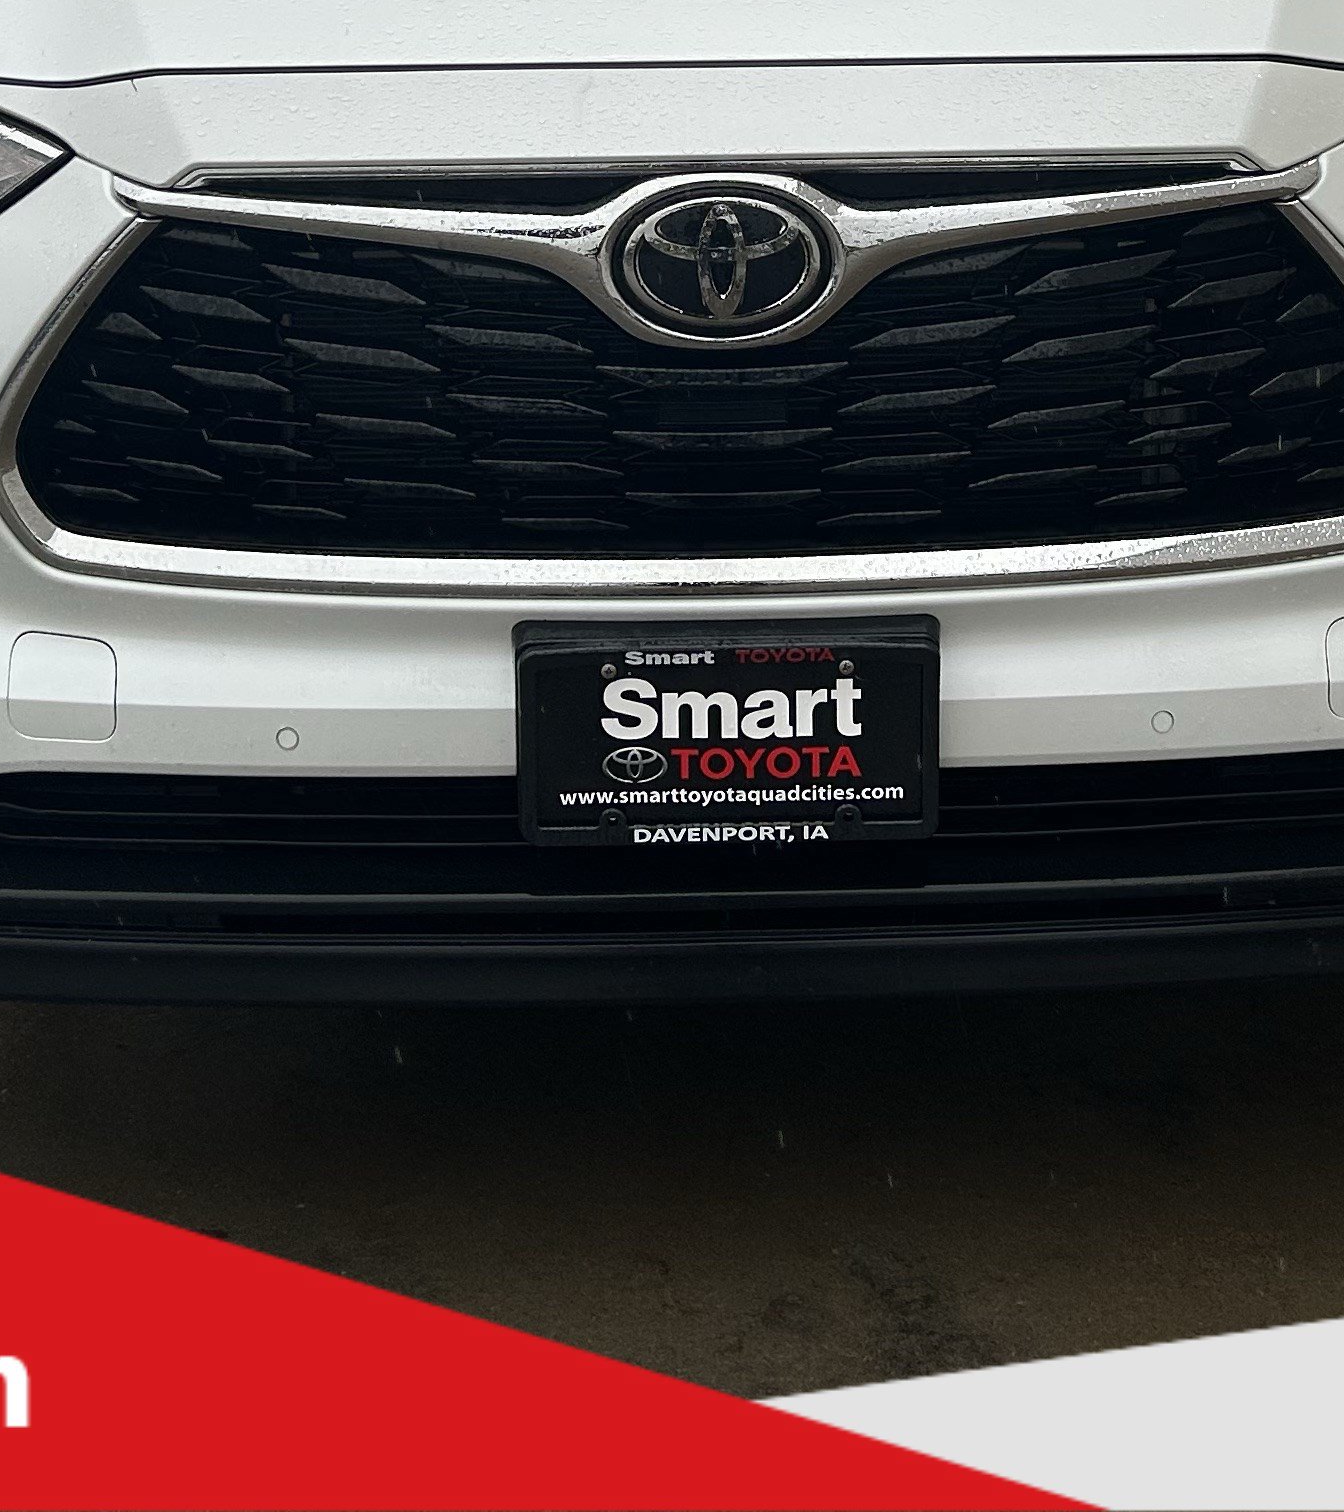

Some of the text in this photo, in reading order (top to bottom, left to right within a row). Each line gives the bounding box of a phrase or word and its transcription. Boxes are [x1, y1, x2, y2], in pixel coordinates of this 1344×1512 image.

[624, 647, 835, 666] Smart TOYOTA
[601, 678, 862, 740] Smart
[671, 745, 862, 780] TOYOTA
[559, 784, 904, 807] www.smarttoyotaquadcities.com
[633, 825, 829, 843] DAVENPORT, IA
